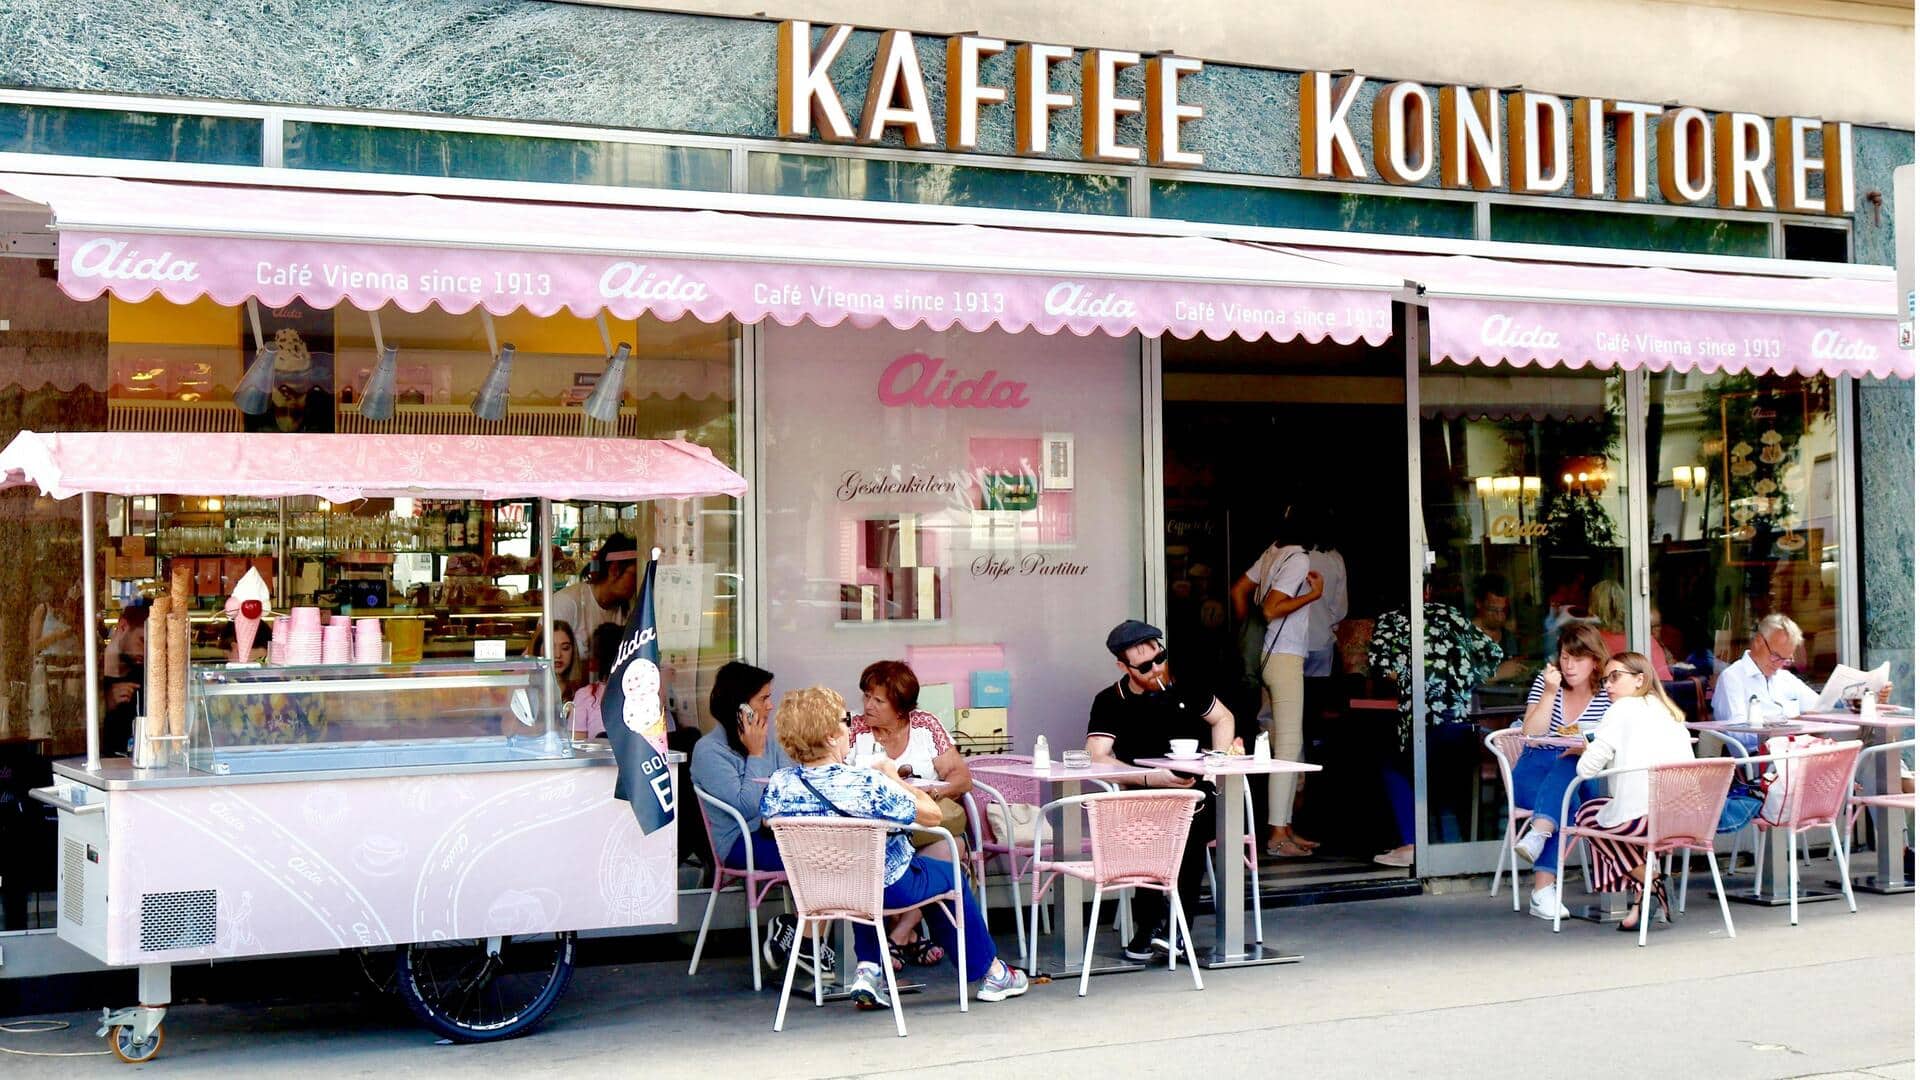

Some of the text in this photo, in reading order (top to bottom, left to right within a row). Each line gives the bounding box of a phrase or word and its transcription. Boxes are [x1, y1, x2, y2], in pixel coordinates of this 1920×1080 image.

[782, 20, 1853, 213] KAFFEE KONDITOREI
[256, 261, 551, 296] Café Vienna since 1913
[754, 283, 1004, 313] Café Vienna since 1913
[1175, 300, 1386, 329] Café Vienna since 1913
[1596, 331, 1781, 358] Café Vienna since 1913
[836, 470, 958, 502] Geschenkideen
[970, 552, 1089, 581] Süße Partitur
